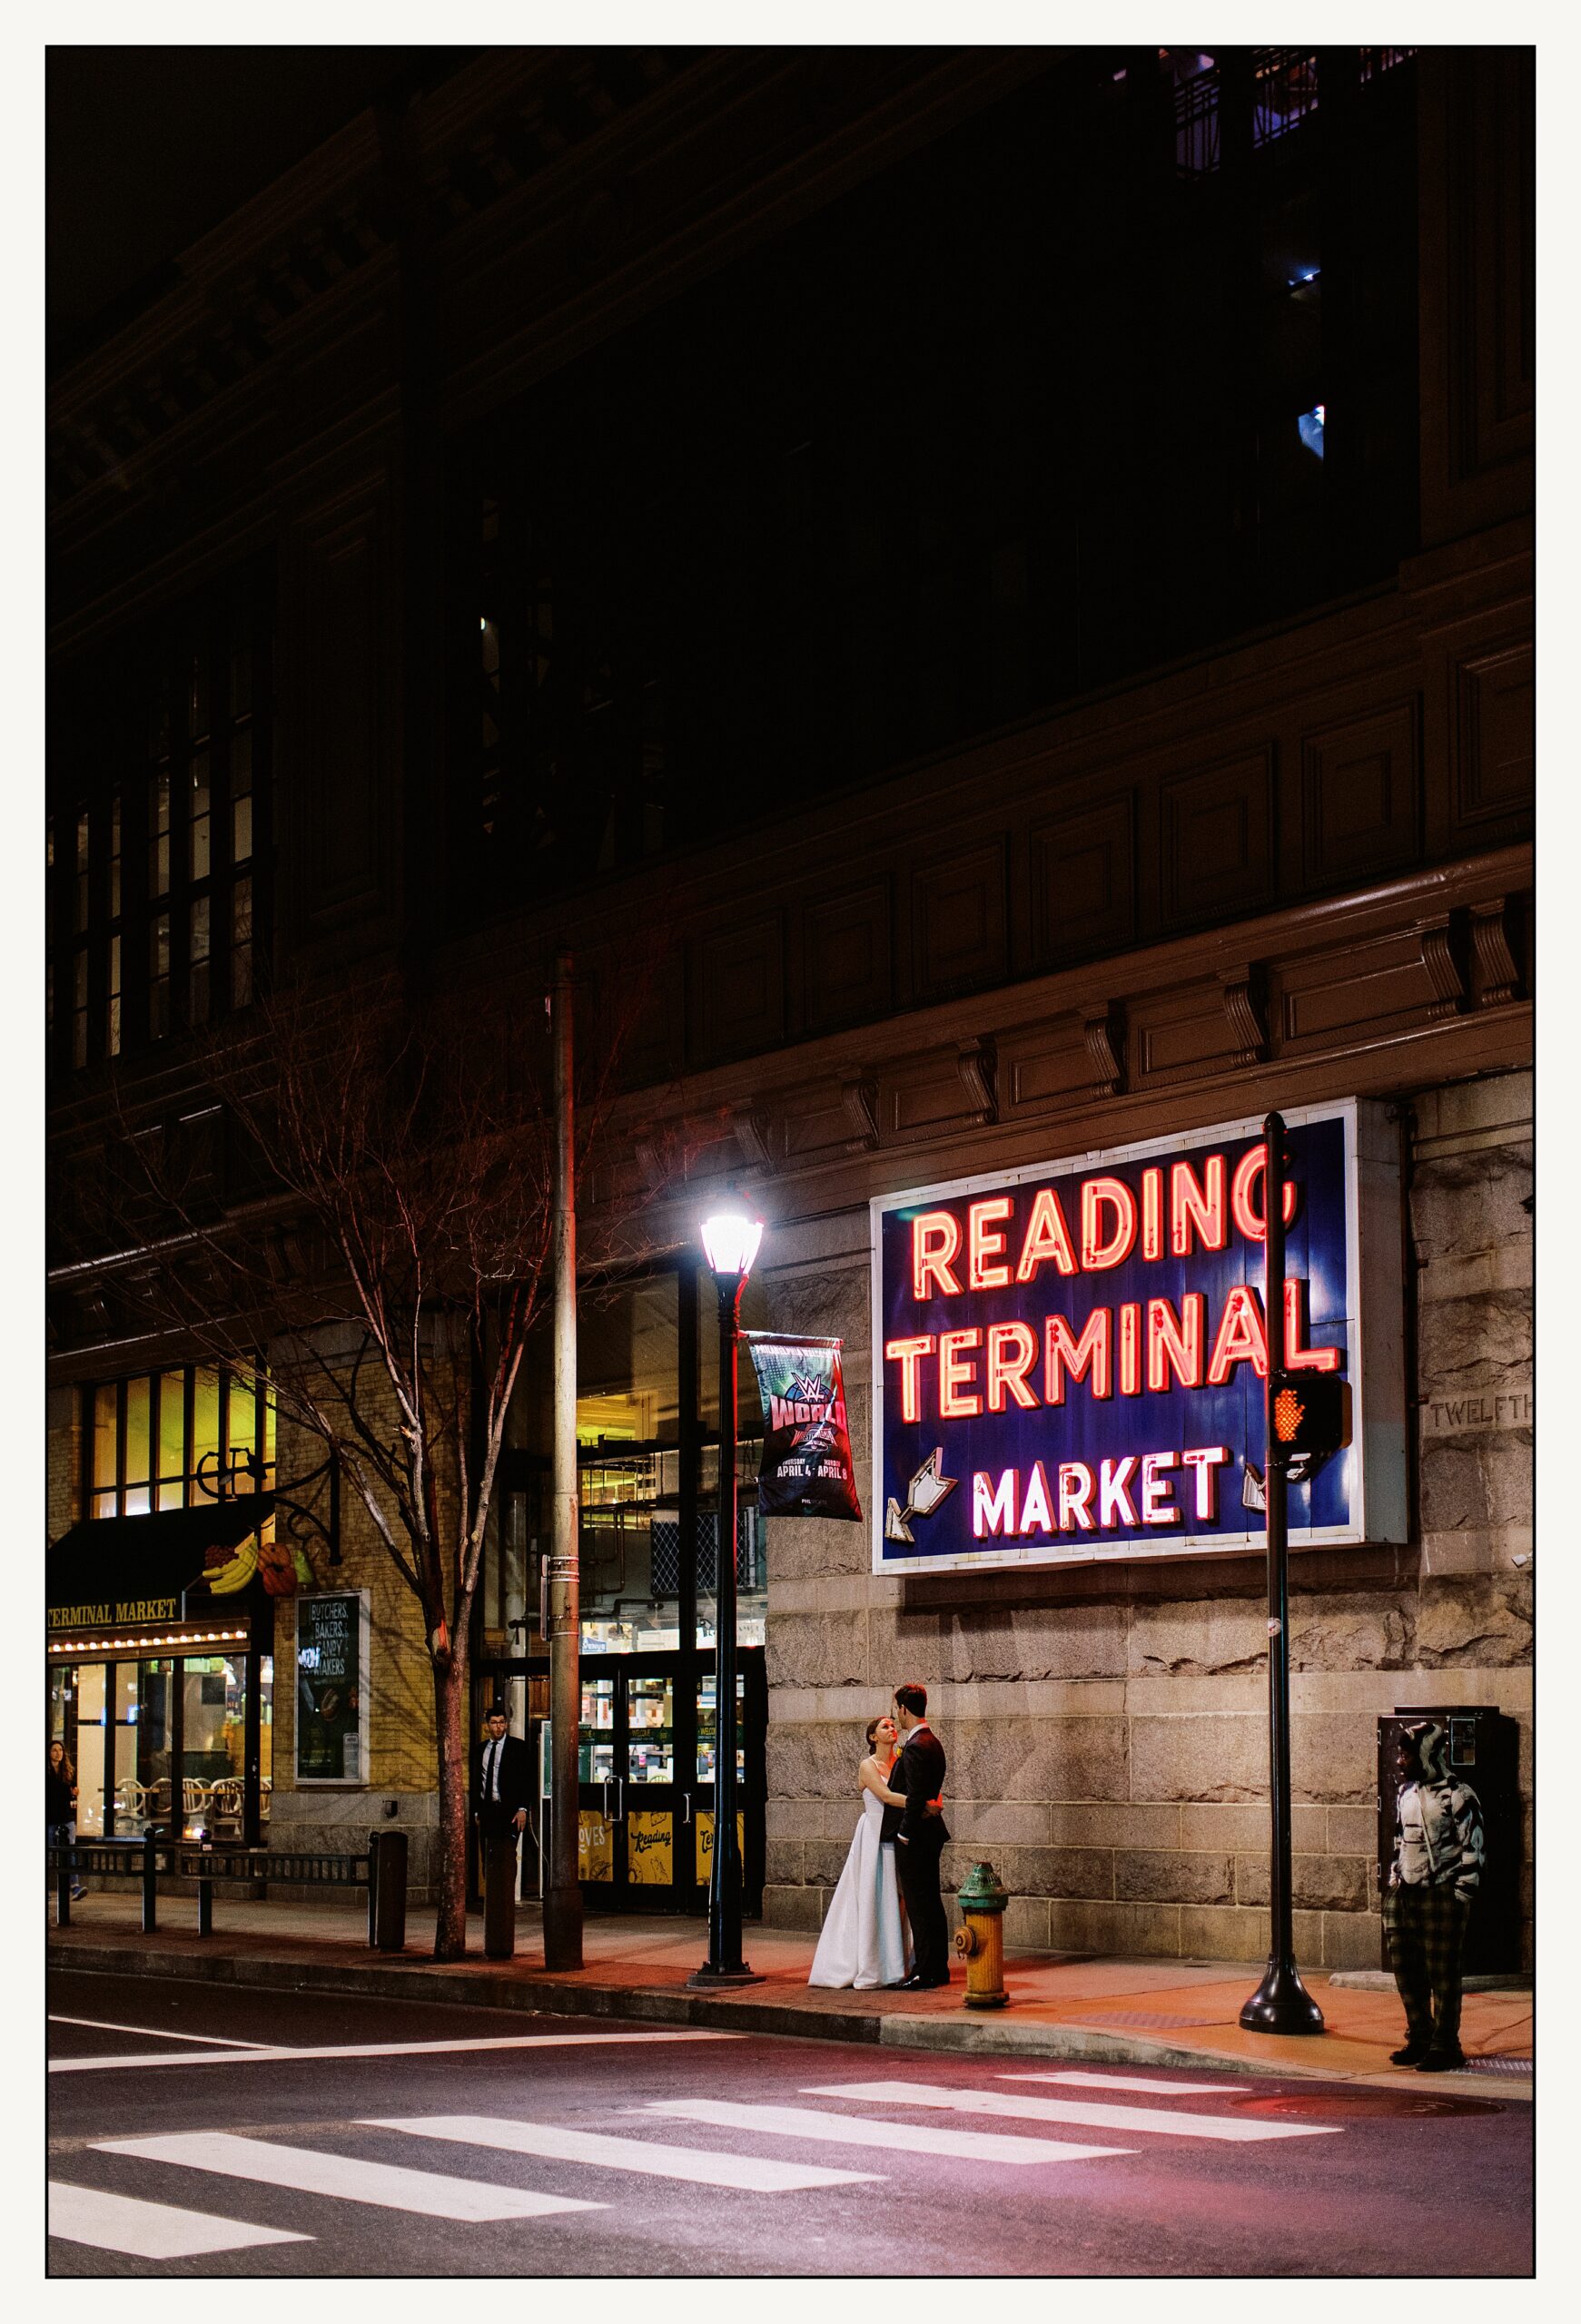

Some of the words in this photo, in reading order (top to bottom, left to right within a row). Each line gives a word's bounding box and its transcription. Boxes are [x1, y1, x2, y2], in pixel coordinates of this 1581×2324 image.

[913, 1143, 1297, 1303] READING
[886, 1278, 1340, 1423] TERMINAL
[770, 1393, 848, 1432] WORLD
[776, 1465, 804, 1478] APRIL
[805, 1465, 811, 1477] 4
[817, 1465, 842, 1479] APRIL
[842, 1468, 847, 1480] 8
[782, 1458, 805, 1466] THURSDAY
[973, 1447, 1228, 1538] MARKET
[115, 1598, 176, 1622] MARKET
[631, 1830, 671, 1854] Reading
